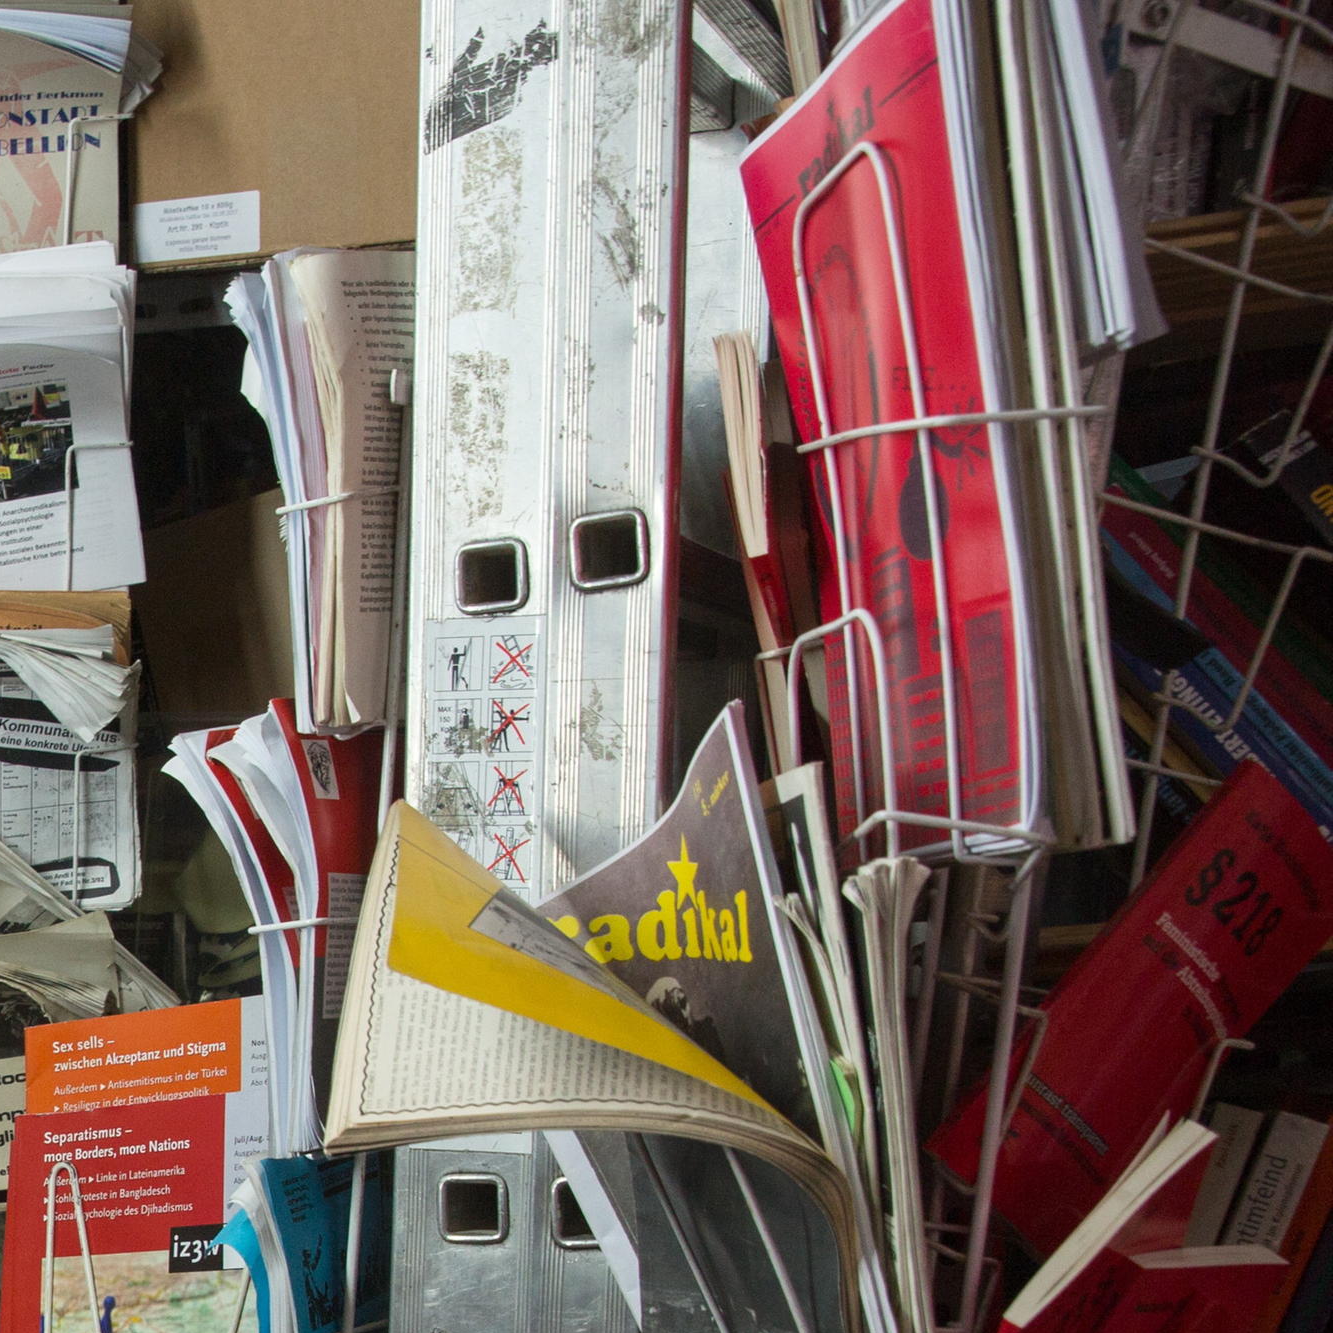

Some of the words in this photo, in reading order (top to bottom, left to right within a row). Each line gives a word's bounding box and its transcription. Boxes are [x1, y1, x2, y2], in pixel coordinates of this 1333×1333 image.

[0, 734, 22, 748] eine
[53, 1039, 73, 1053] Sex
[77, 1036, 104, 1050] sells
[54, 1055, 102, 1073] zwischen
[105, 1051, 160, 1068] Akzeptanz
[163, 1046, 184, 1060] und
[187, 1041, 226, 1057] Stigma
[54, 1083, 98, 1096] Außerdem
[107, 1074, 173, 1090] Antisemitismus
[175, 1073, 183, 1081] in
[185, 1070, 199, 1081] der
[201, 1067, 227, 1079] Türkei
[102, 1100, 111, 1108] in
[112, 1096, 127, 1106] der
[44, 1126, 122, 1146] Separatismus
[44, 1151, 72, 1163] more
[75, 1145, 117, 1161] Borders,
[119, 1143, 146, 1155] more
[149, 1138, 190, 1152] Nations
[96, 1171, 118, 1183] Linke
[119, 1171, 127, 1181] in
[129, 1166, 185, 1181] Lateinamerika
[109, 1190, 118, 1200] in
[119, 1184, 170, 1199] Bangladesch
[124, 1205, 139, 1216] des
[140, 1203, 193, 1216] Djihadismus
[173, 1235, 219, 1263] iz3w
